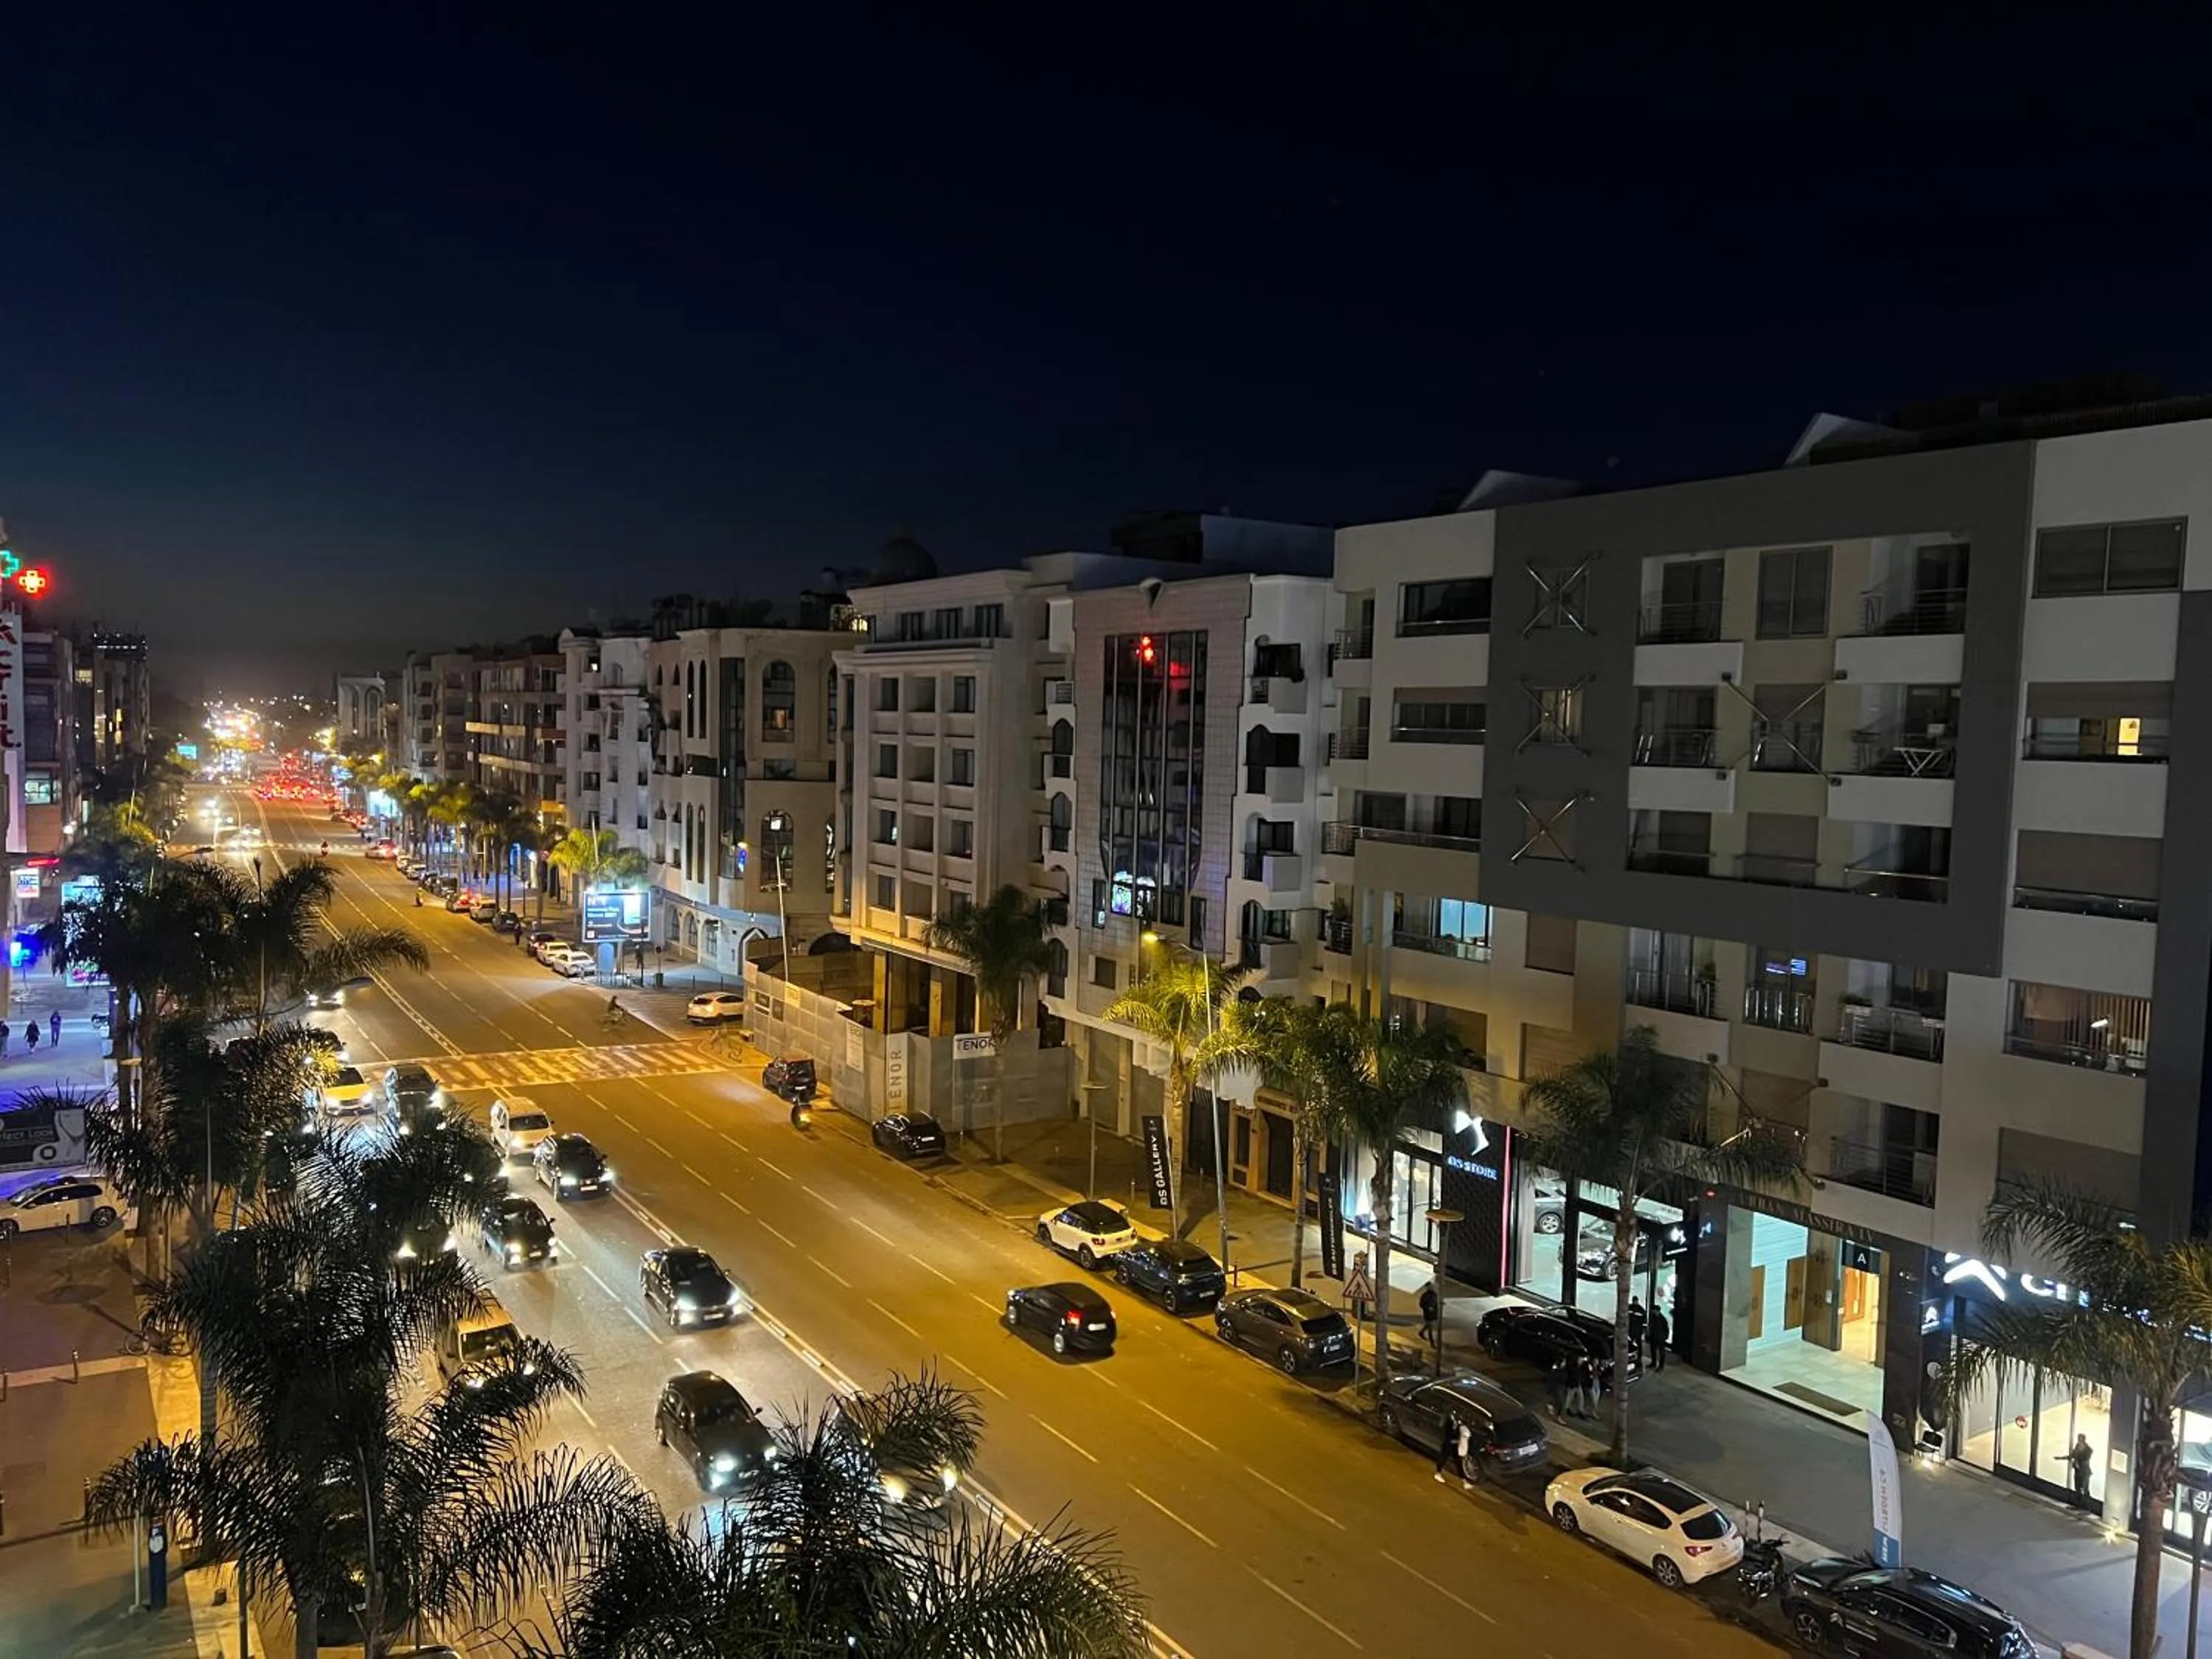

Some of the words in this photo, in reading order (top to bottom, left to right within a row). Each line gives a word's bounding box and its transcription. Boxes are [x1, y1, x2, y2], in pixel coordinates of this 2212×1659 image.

[1151, 1135, 1166, 1188] GALLERY
[1447, 1155, 1464, 1169] DS
[1464, 1161, 1498, 1180] STORE
[1158, 1189, 1169, 1206] DS
[1857, 1253, 1867, 1265] A
